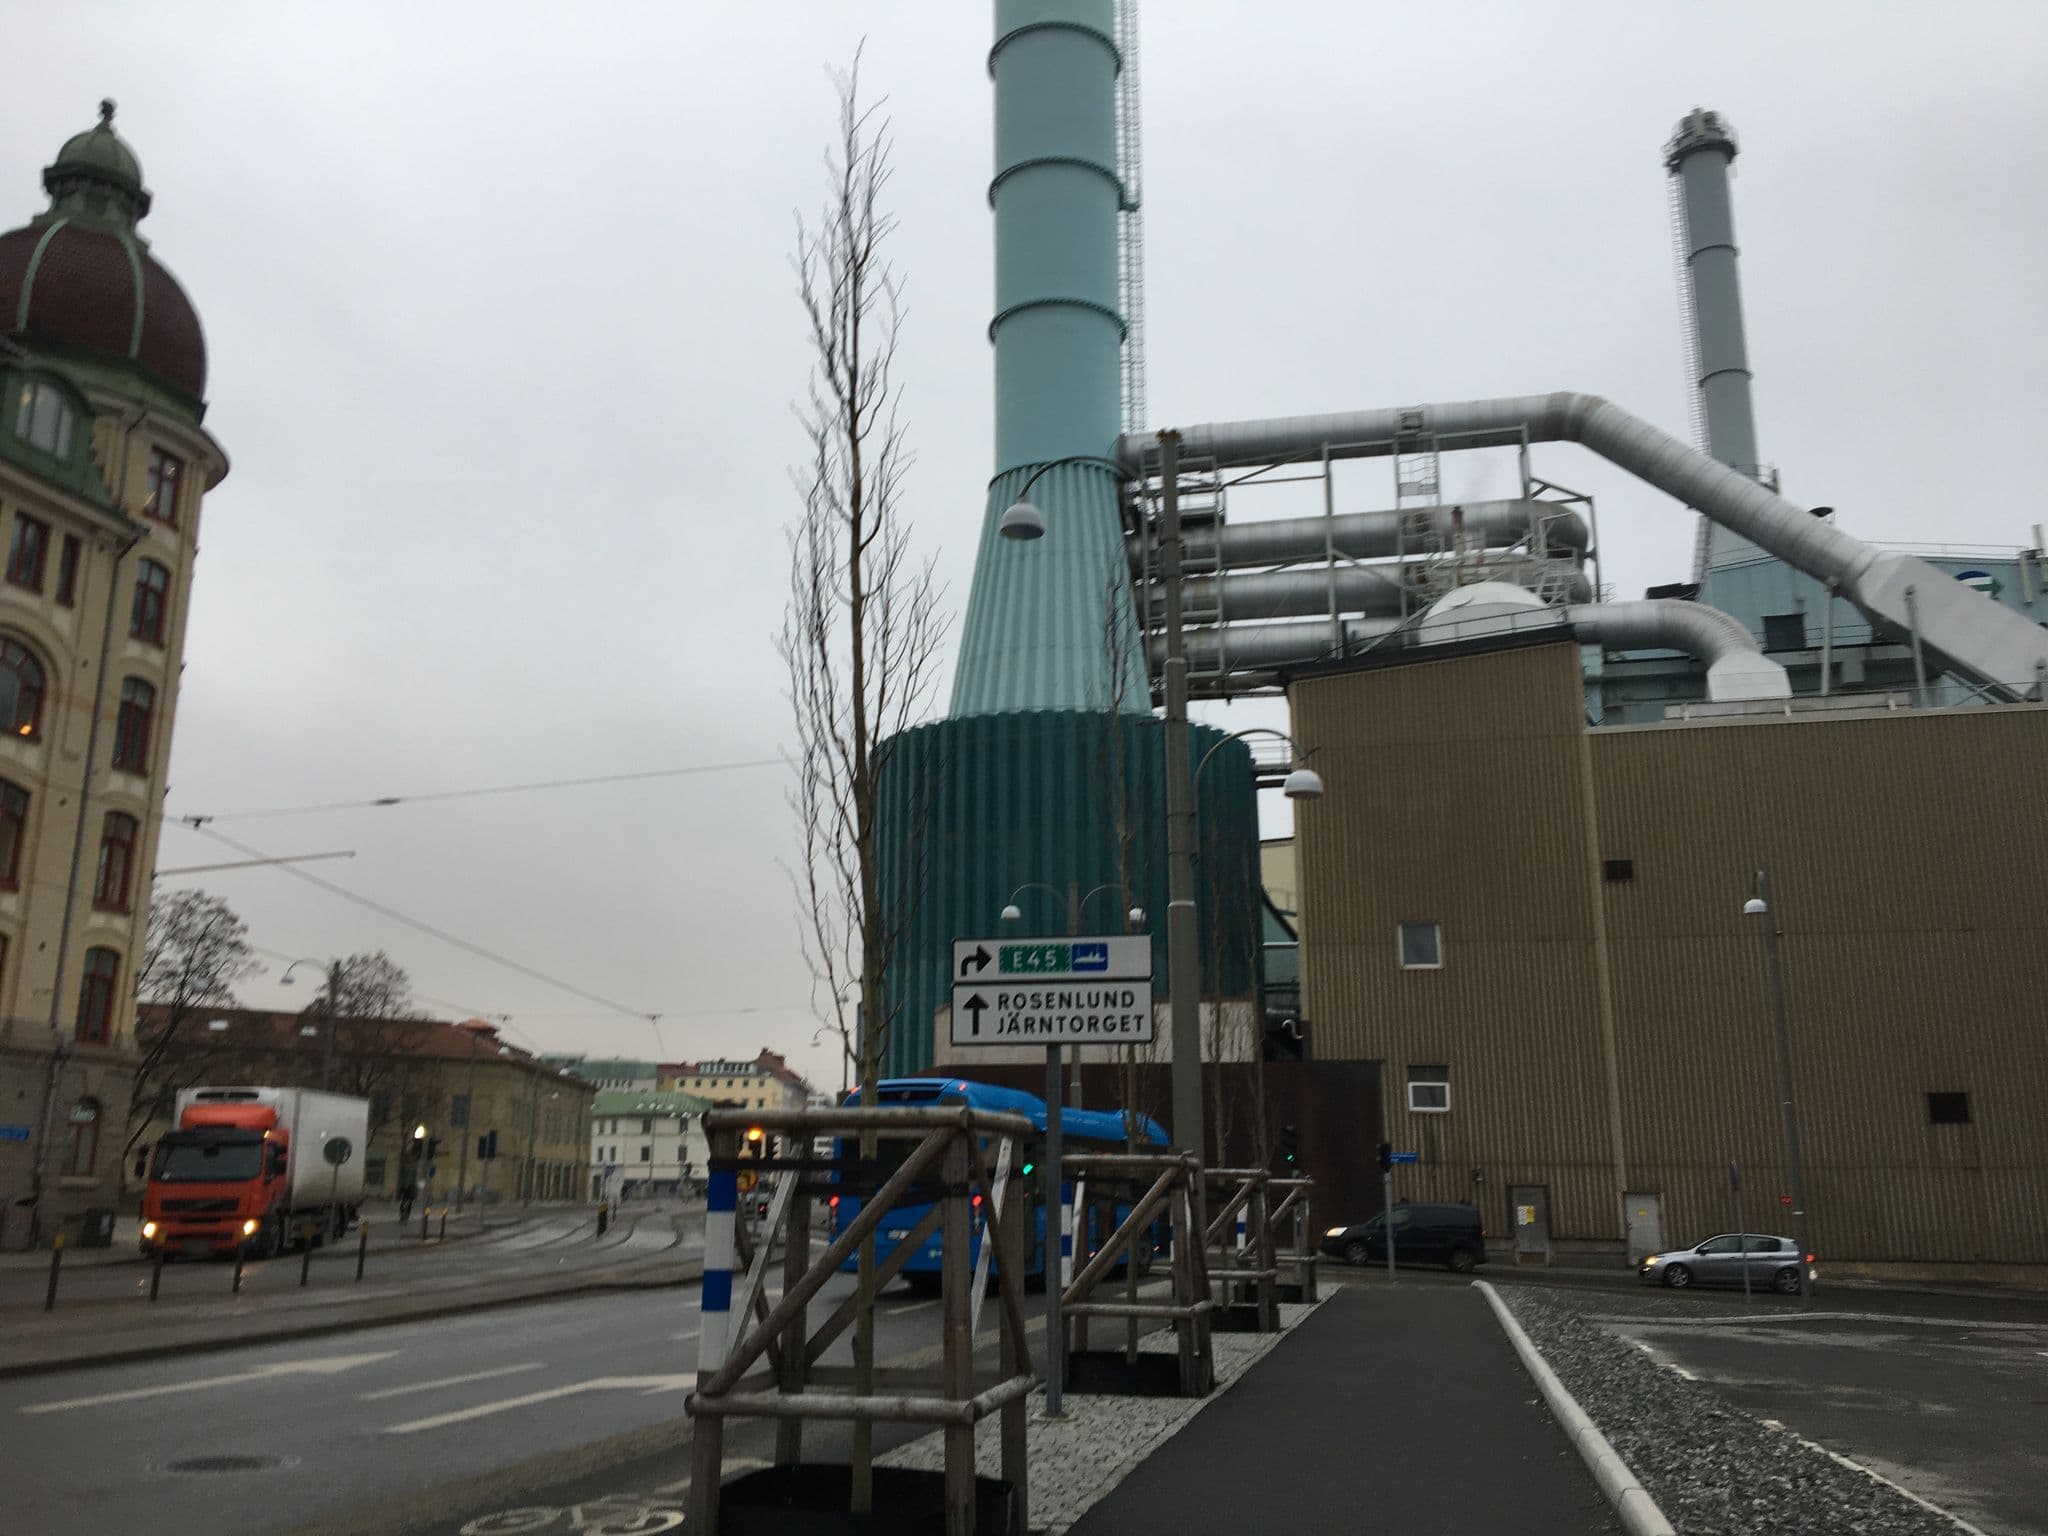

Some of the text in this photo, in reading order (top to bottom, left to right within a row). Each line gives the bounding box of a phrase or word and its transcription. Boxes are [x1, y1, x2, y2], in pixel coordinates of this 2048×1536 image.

[1012, 950, 1057, 968] E45
[997, 990, 1135, 1011] ROSENLUND
[997, 1012, 1145, 1035] JÄRNTORGET
